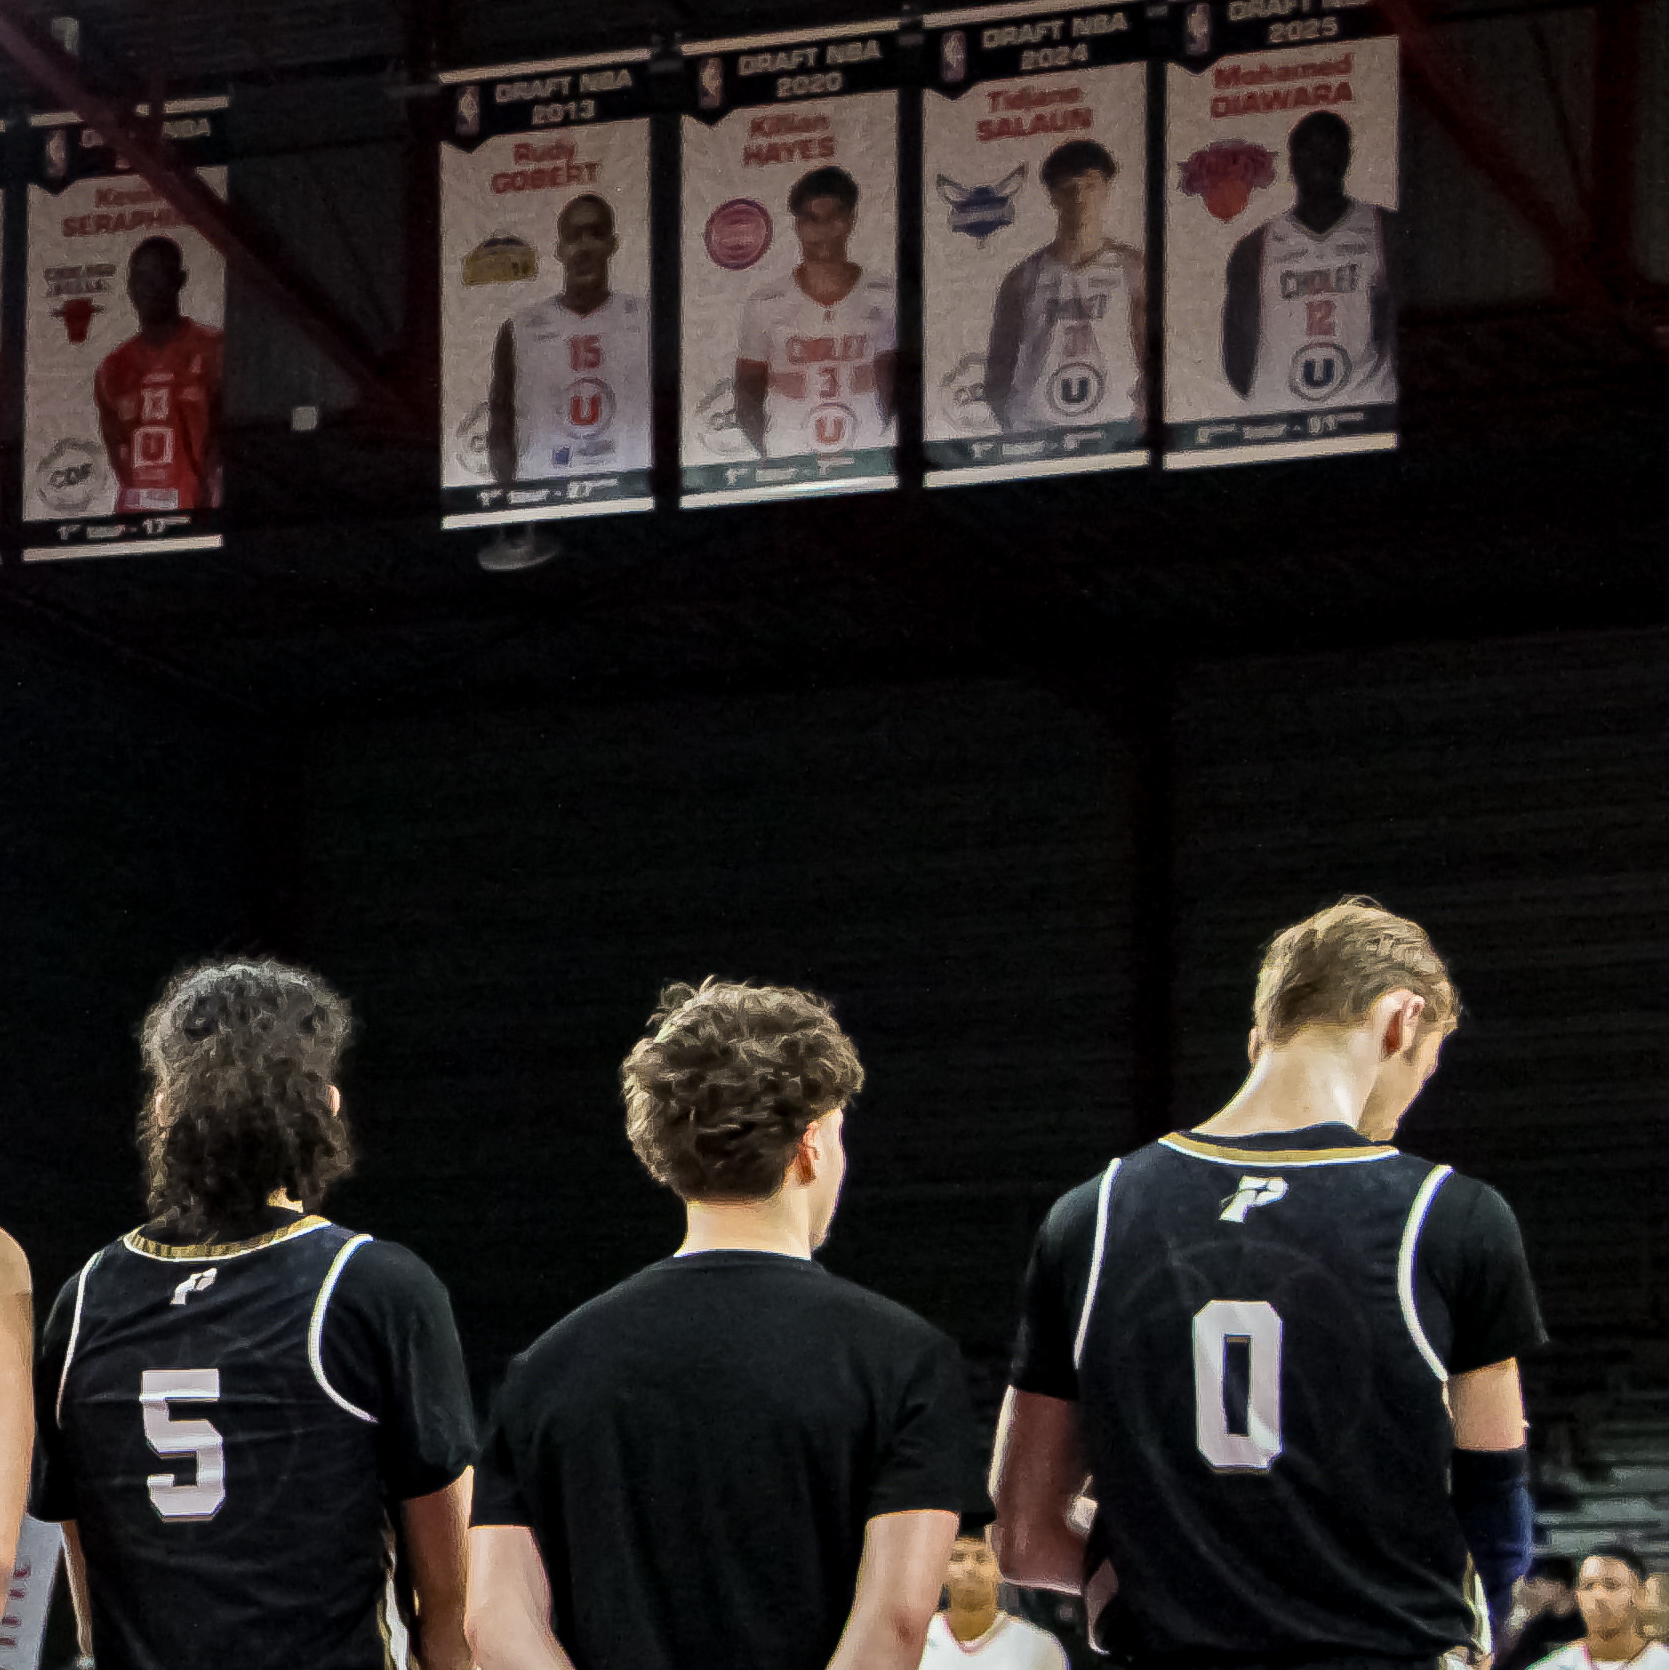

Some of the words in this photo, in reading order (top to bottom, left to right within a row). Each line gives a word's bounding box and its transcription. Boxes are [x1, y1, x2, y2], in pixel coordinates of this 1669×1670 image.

[982, 20, 1063, 48] DRAFT
[1071, 13, 1128, 36] NBA
[1268, 17, 1339, 43] 2025
[738, 47, 818, 75] DRAFT
[826, 41, 880, 65] NBA
[1021, 44, 1088, 70] 2024
[495, 76, 573, 103] DRAFT
[579, 69, 632, 93] NBA
[776, 72, 843, 98] 2020
[1211, 81, 1353, 119] DIAWARA
[531, 100, 595, 126] 2013
[743, 136, 836, 167] HAYES
[491, 162, 599, 195] GOBERT
[1193, 1300, 1283, 1474] 0
[140, 1368, 227, 1524] 5
